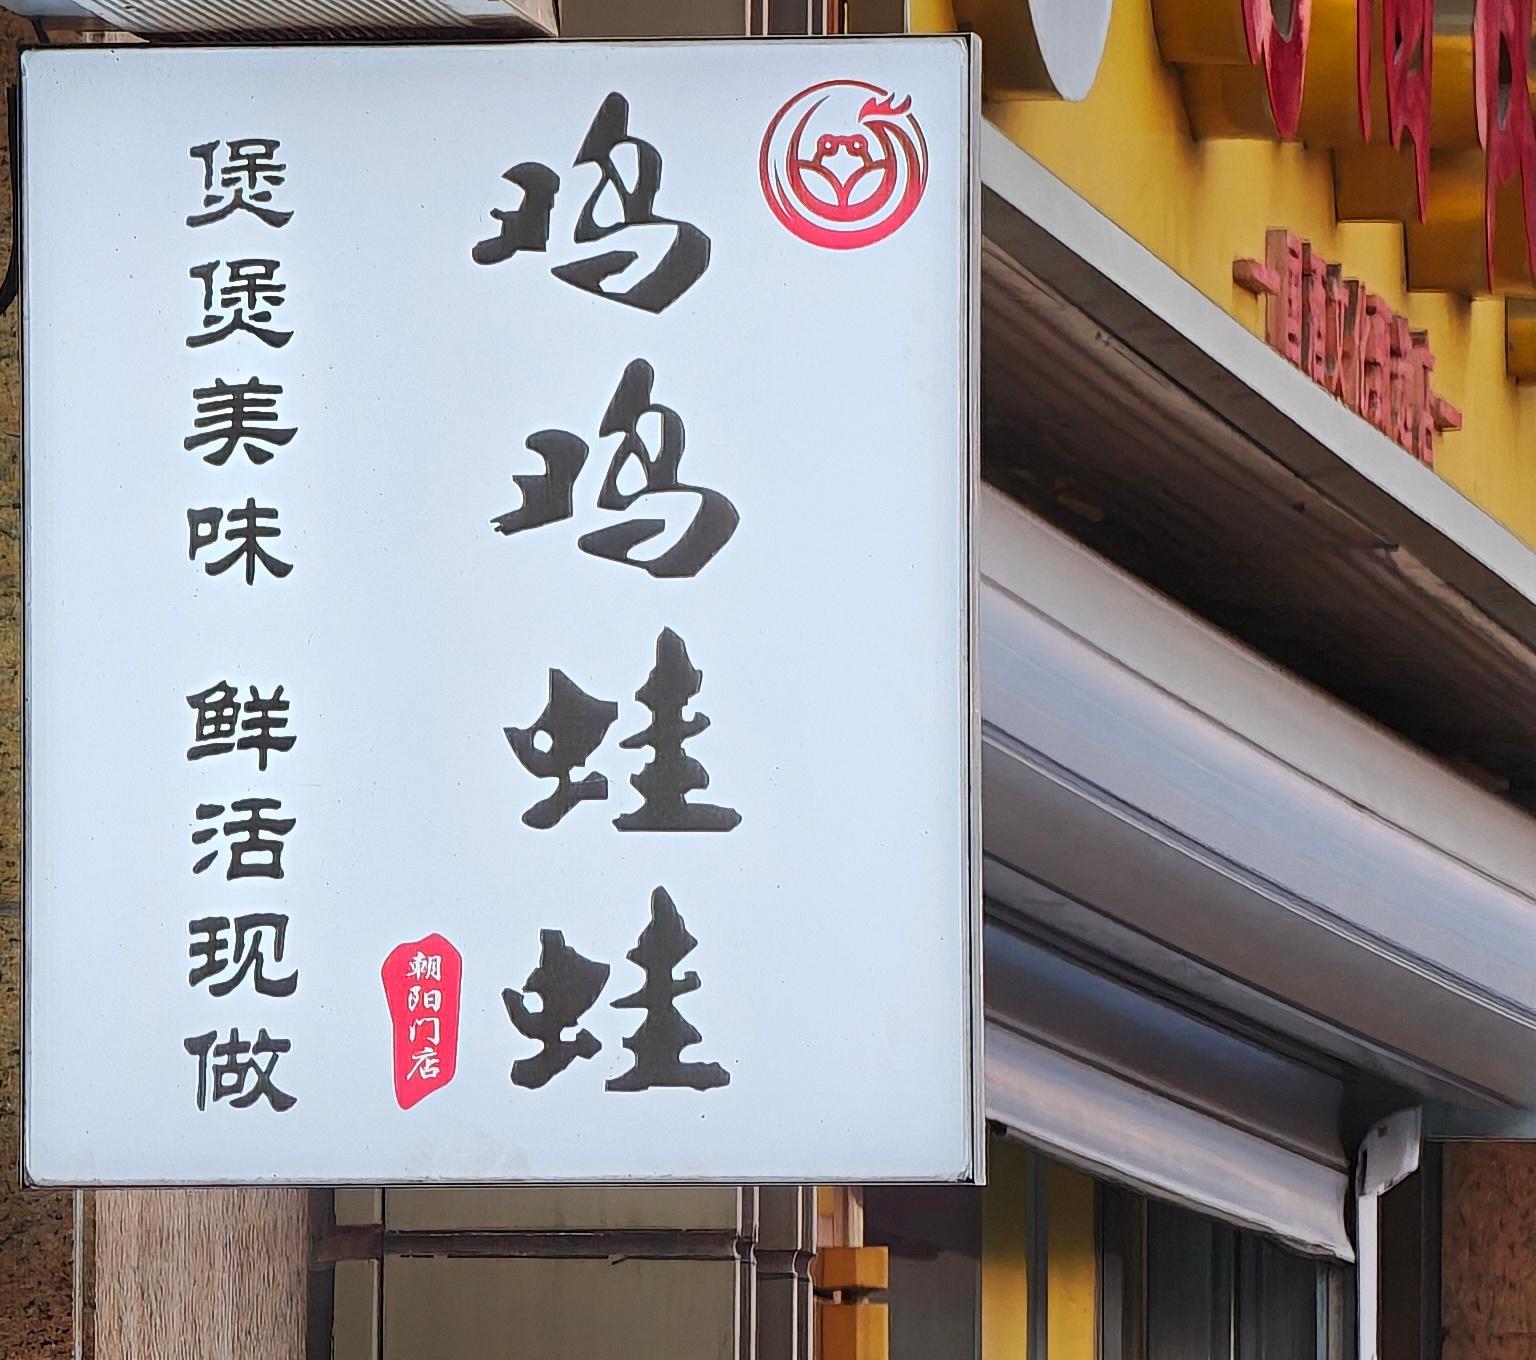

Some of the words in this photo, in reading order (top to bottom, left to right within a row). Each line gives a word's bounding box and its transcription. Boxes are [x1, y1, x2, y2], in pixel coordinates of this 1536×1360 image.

[184, 137, 298, 586] 煲煲美味
[471, 91, 743, 1093] 鸡鸡蛙蛙
[184, 680, 299, 1113] 鲜活现做
[405, 950, 443, 1081] 朝阳门店
